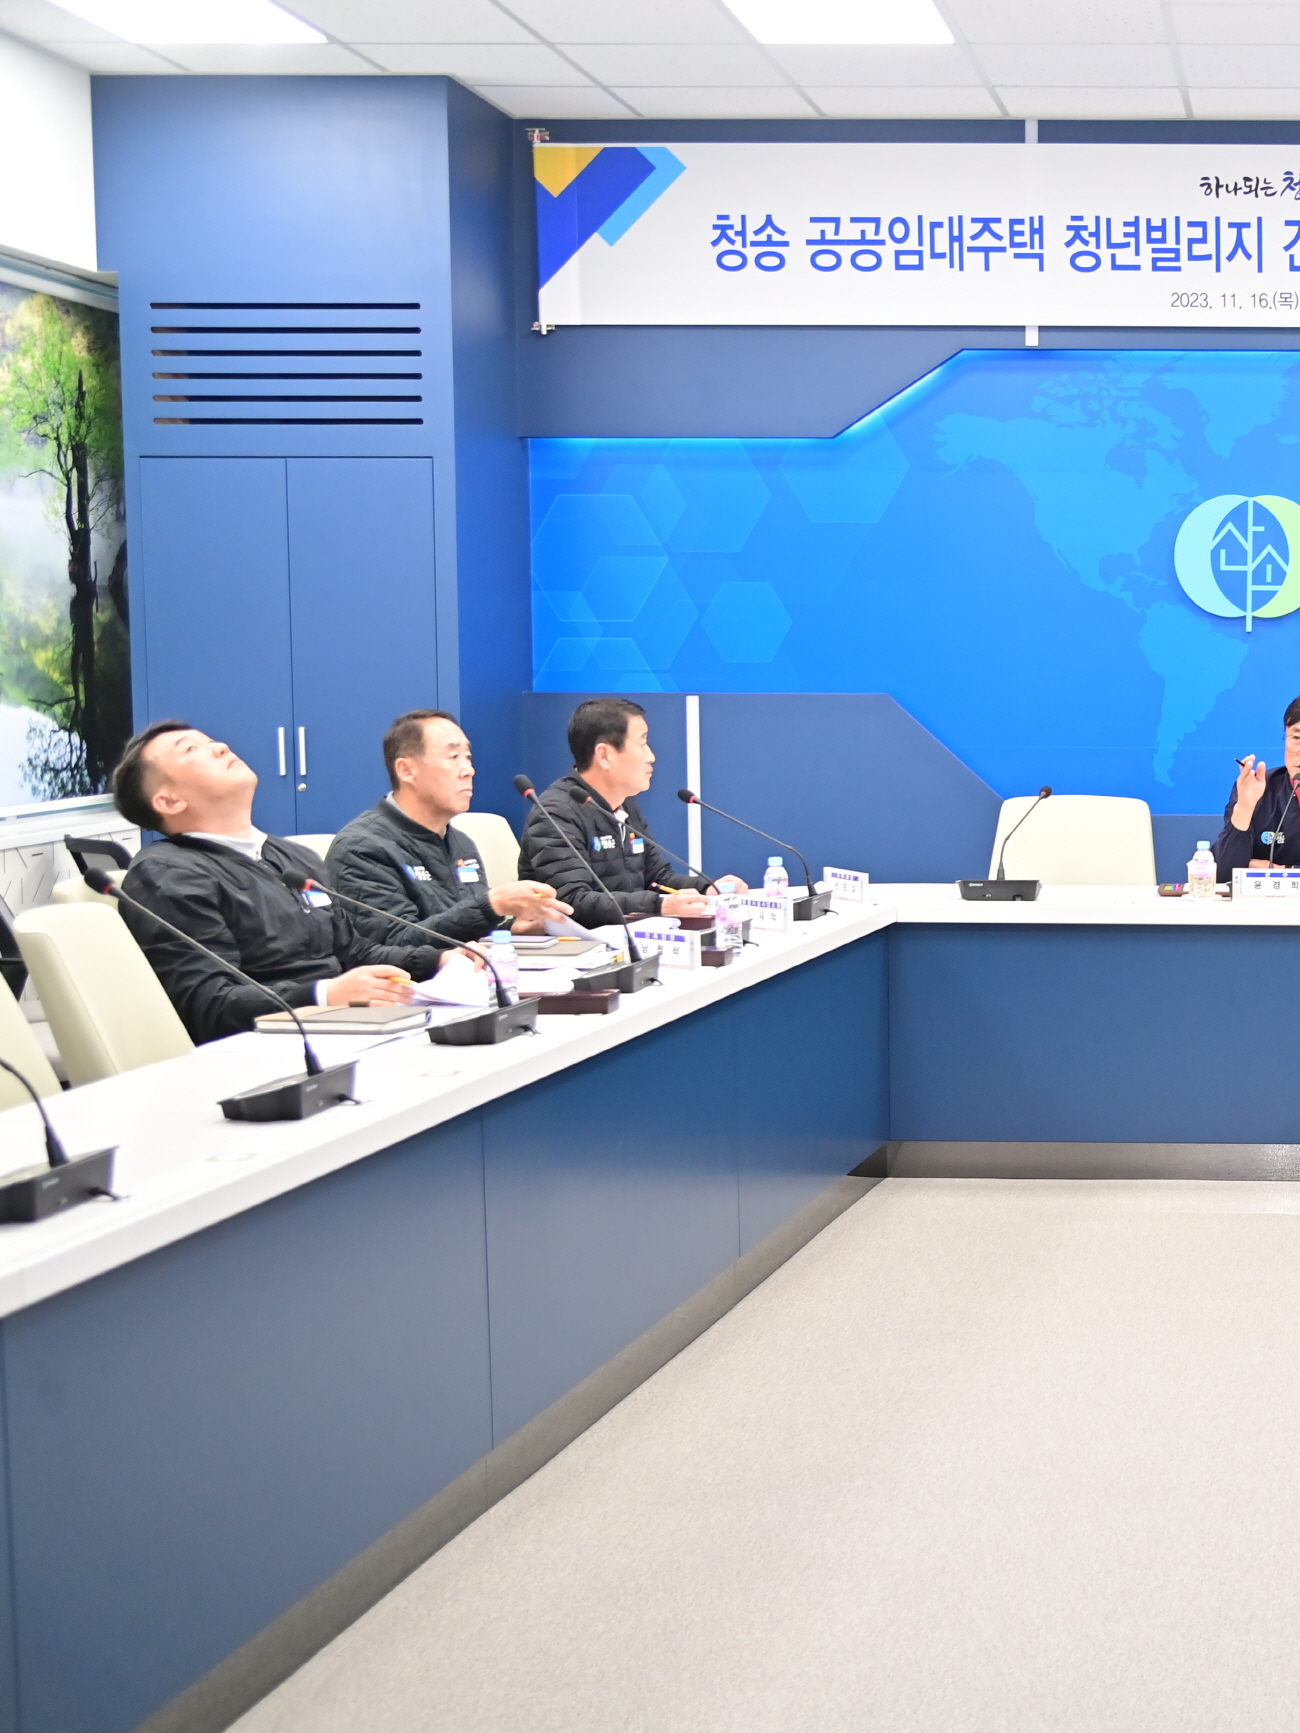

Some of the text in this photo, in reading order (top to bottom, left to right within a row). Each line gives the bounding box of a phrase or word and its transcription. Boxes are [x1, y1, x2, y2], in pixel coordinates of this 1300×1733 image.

[1199, 175, 1277, 199] 하나되는
[710, 214, 790, 272] 청송
[805, 214, 1045, 273] 공공임대주택
[1063, 214, 1264, 274] 청년빌리지
[1170, 292, 1213, 310] 2023.
[1220, 293, 1243, 310] 11.
[1250, 291, 1299, 310] 16.(목)
